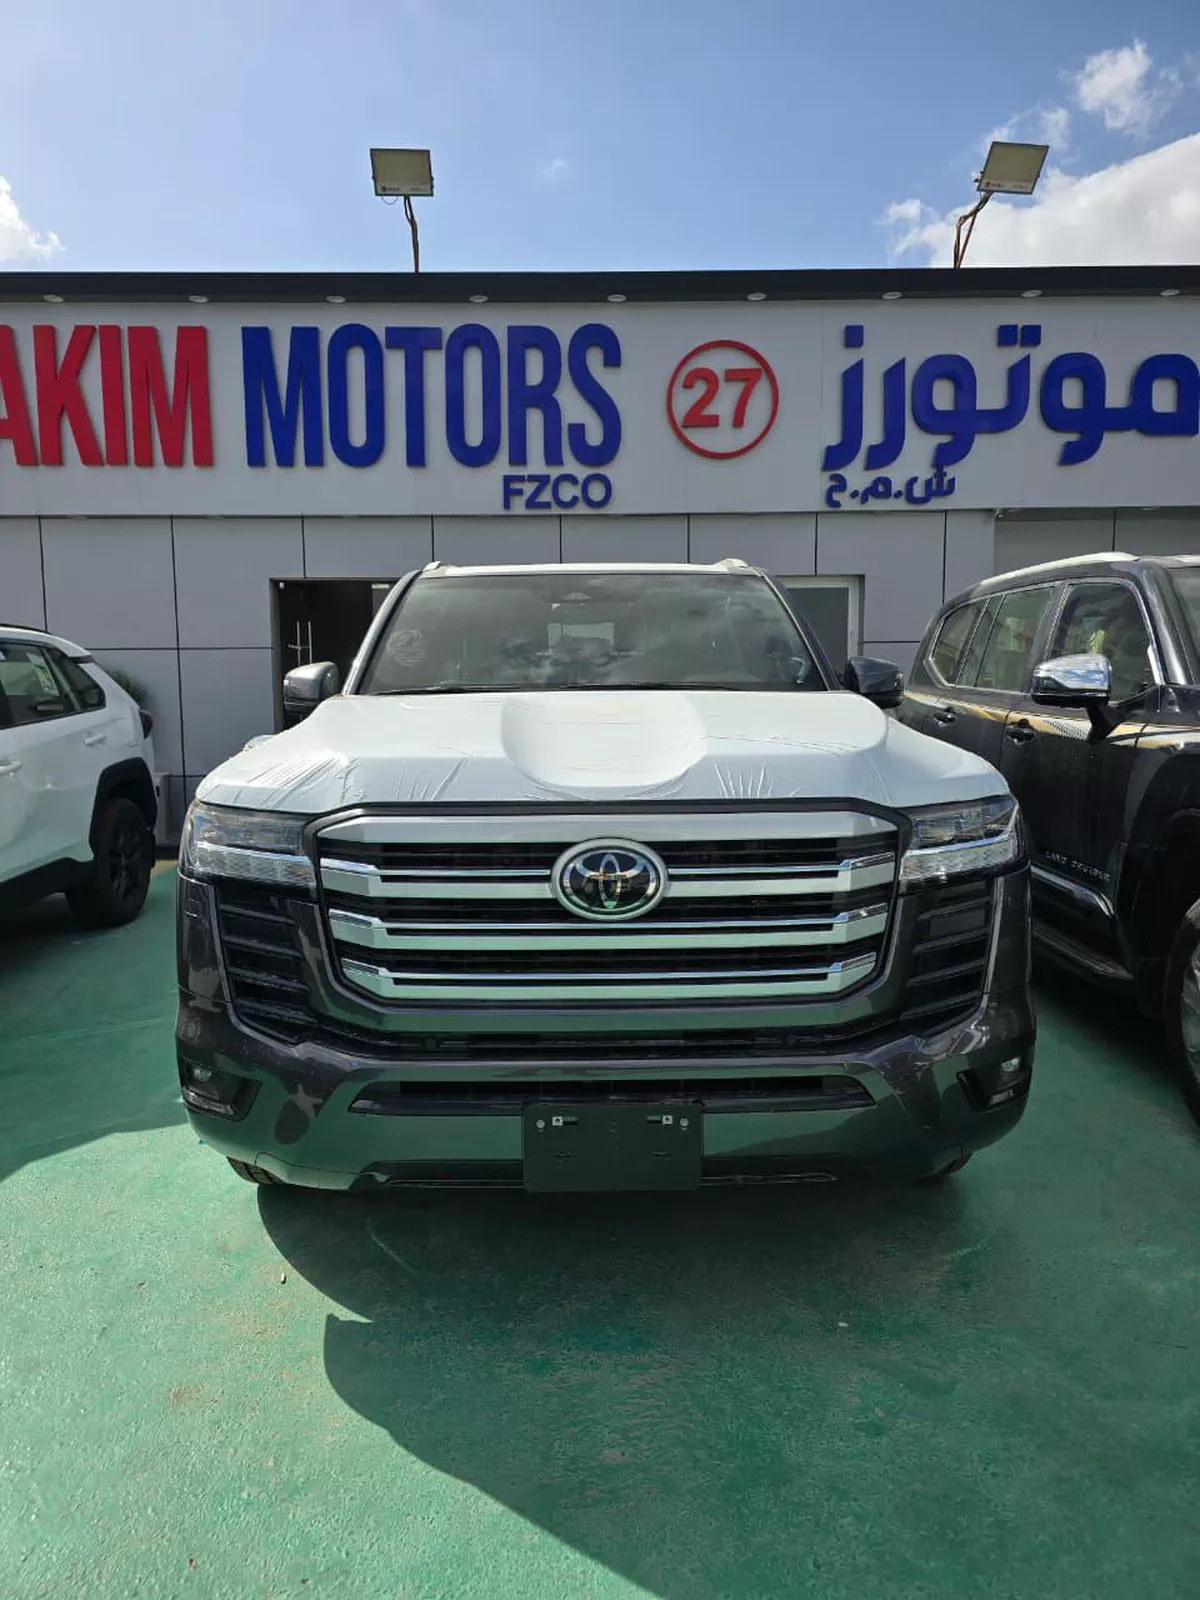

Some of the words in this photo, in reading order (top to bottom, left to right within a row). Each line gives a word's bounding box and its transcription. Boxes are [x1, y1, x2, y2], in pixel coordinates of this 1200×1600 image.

[241, 323, 623, 468] MOTORS
[680, 367, 763, 429] 27
[821, 324, 1200, 471] موتورز
[502, 474, 613, 510] FZCO
